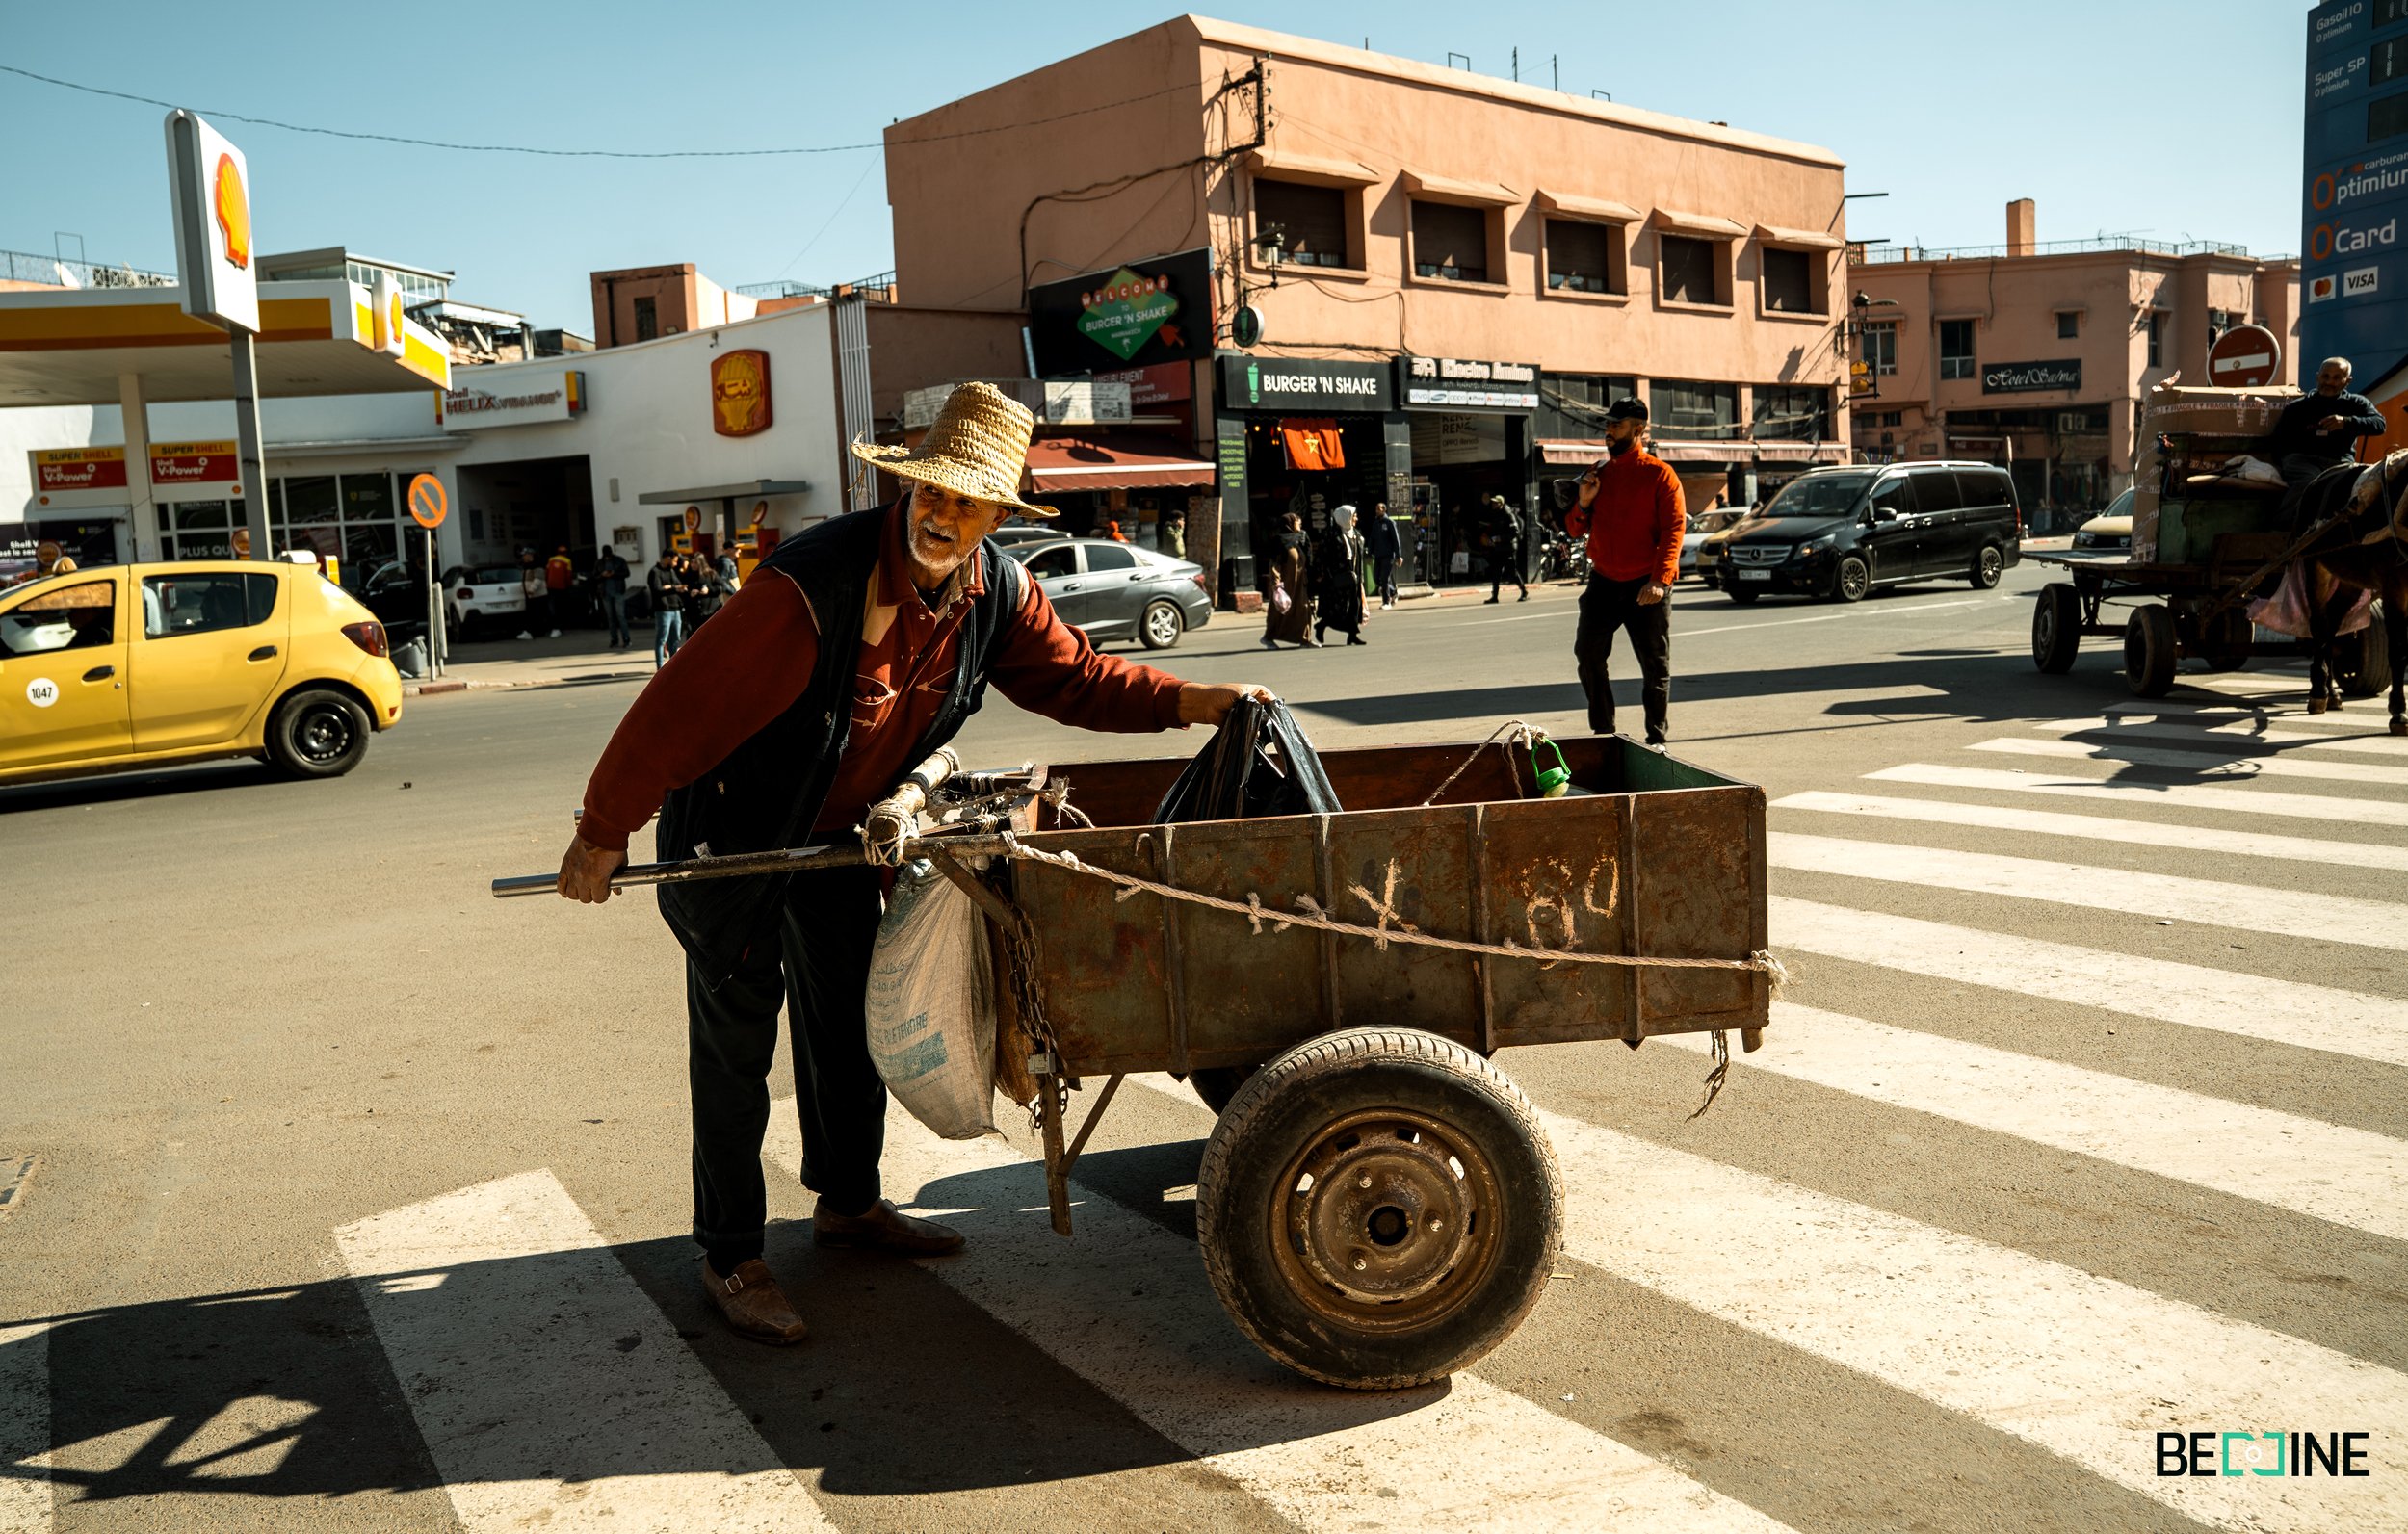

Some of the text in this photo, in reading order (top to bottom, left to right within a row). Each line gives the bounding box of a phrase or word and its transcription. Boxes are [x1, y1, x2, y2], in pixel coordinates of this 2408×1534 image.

[2316, 7, 2348, 31] Gasoil
[2315, 57, 2366, 86] Super SP
[2347, 273, 2375, 289] VISA
[1082, 279, 1165, 306] WELCOME
[1086, 316, 1122, 331] BURGER
[1137, 306, 1167, 322] SHAKE
[1441, 359, 1490, 379] Electro
[1492, 362, 1534, 382] Amine
[1987, 369, 2031, 386] Hotel
[1263, 375, 1377, 395] BURGER 'N SHAKE
[446, 387, 468, 400] Shell
[446, 396, 494, 415] HELIX
[2170, 403, 2197, 413] FRAGILE
[2207, 402, 2234, 410] FRAGILE
[48, 450, 113, 461] SUPER SHELL
[162, 444, 224, 455] SUPER SHELL
[44, 472, 92, 482] V-Power
[157, 466, 205, 476] V-Power
[10, 540, 32, 550] Shell
[180, 546, 208, 557] PLUS
[32, 687, 52, 699] 1047
